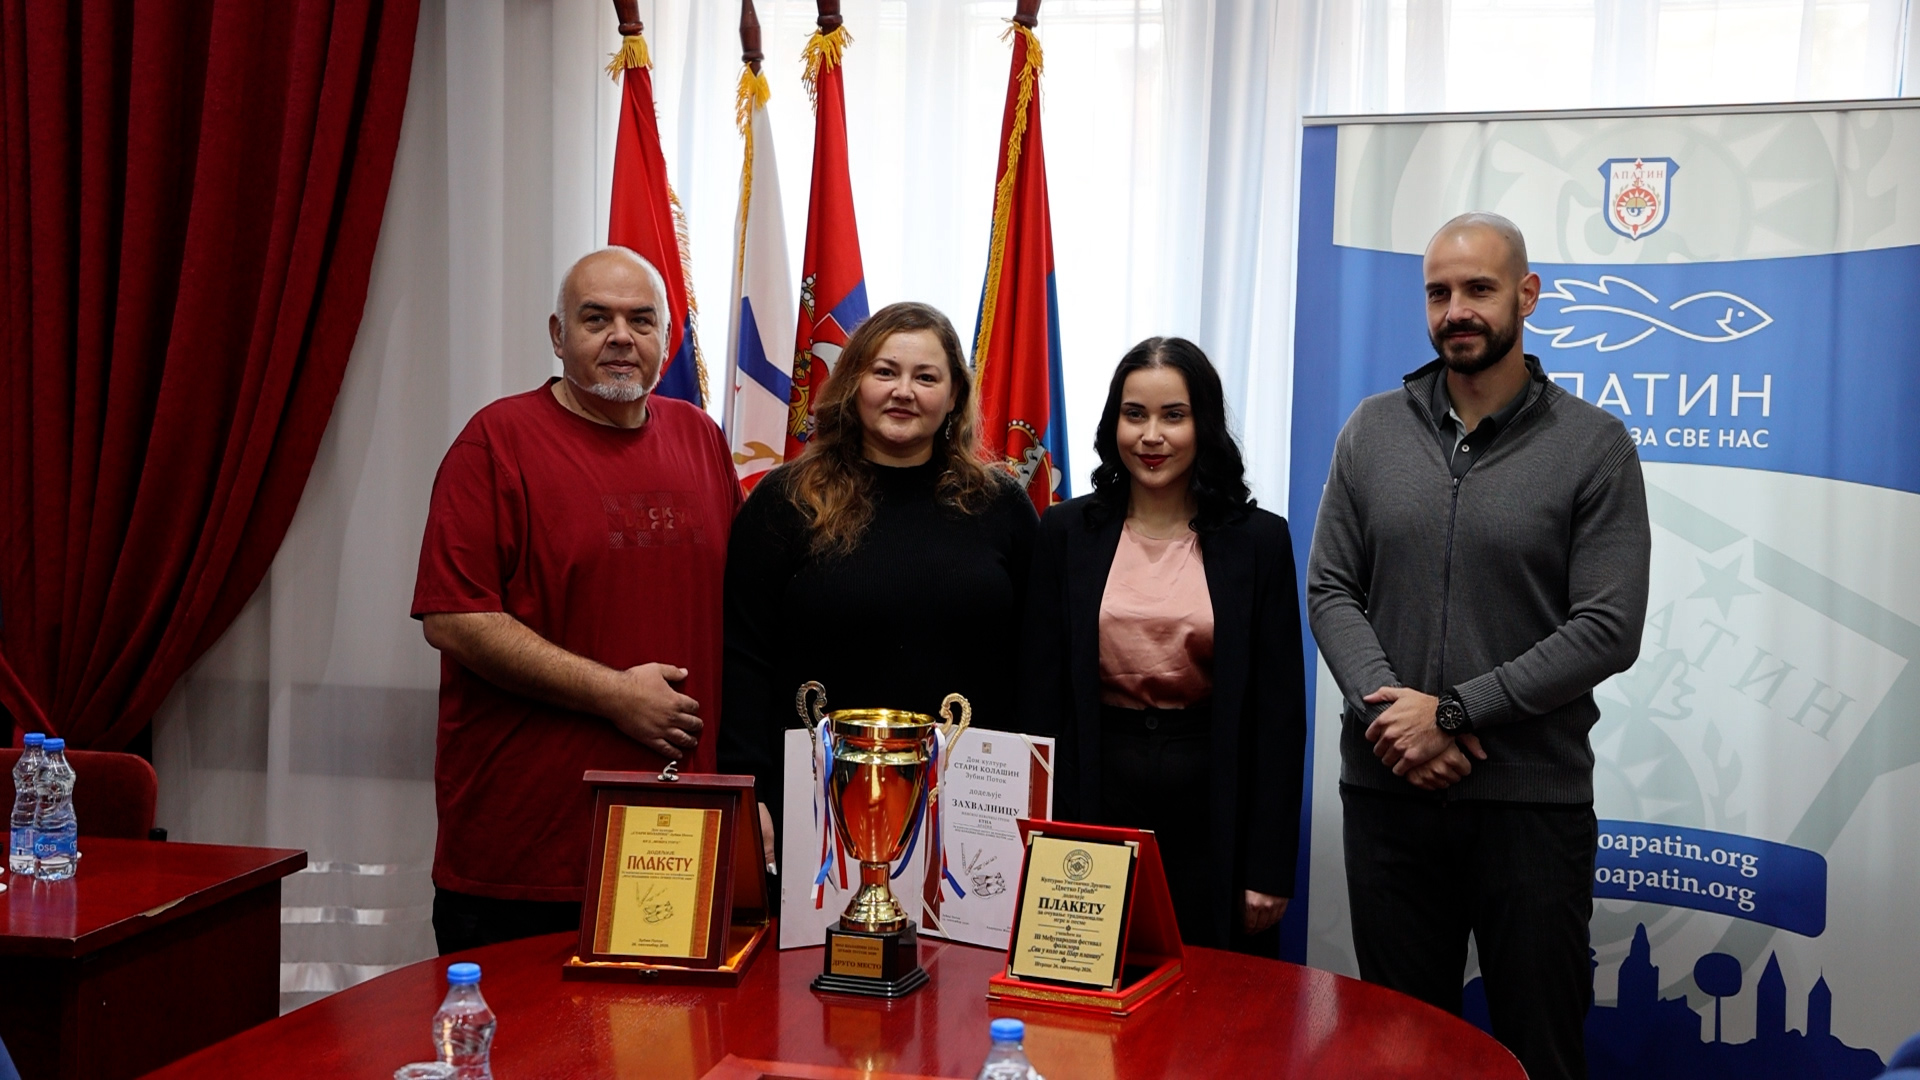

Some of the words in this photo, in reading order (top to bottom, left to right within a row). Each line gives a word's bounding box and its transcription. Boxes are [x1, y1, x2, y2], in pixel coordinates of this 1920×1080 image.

[1612, 170, 1663, 179] АПАТИН
[1547, 372, 1772, 417] ПАТИН
[1630, 427, 1658, 447] ЗА
[1665, 428, 1710, 448] СВЕ
[1718, 429, 1769, 448] НАС
[1647, 599, 1857, 743] АТИН
[954, 762, 978, 771] СТАРИ
[980, 767, 1019, 778] КОЛАШИН
[981, 760, 1007, 768] културе
[965, 772, 985, 781] Зубин
[986, 776, 1007, 784] Поток
[969, 789, 1002, 800] додељује
[952, 799, 1020, 817] ЗАХВАЛНИЦУ
[35, 843, 57, 852] rosa
[1597, 833, 1758, 878] oapatin.org
[627, 856, 693, 872] ПЛАКЕТУ
[1595, 867, 1756, 912] oapatin.org
[1038, 896, 1106, 915] ПЛАКЕТУ
[857, 961, 882, 970] МЕСТО
